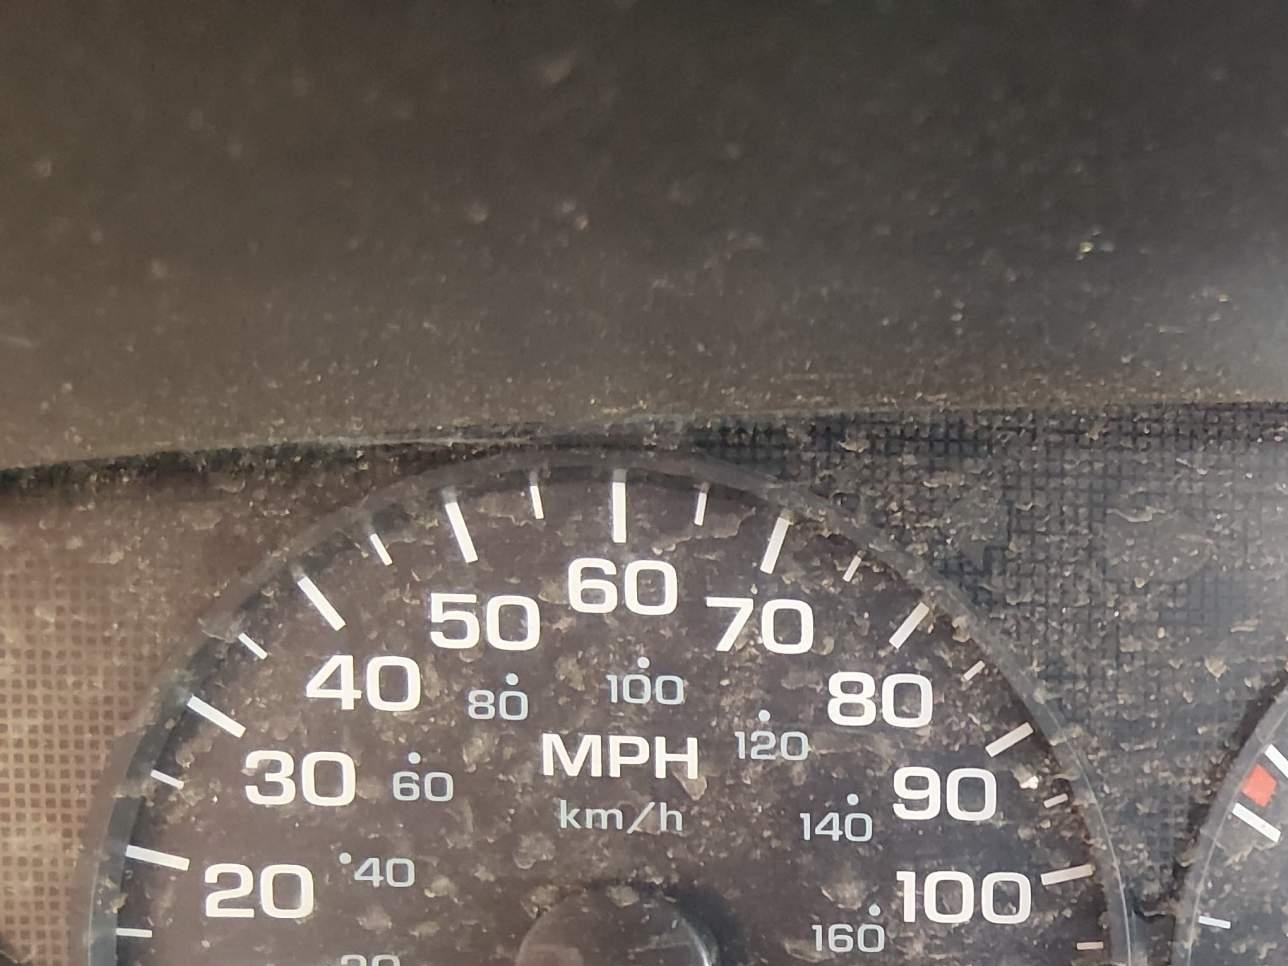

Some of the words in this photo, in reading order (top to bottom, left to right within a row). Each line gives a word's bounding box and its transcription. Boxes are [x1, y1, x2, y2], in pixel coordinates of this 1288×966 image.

[568, 558, 678, 615] 60
[431, 593, 540, 650] 50
[706, 597, 813, 654] 70
[306, 655, 420, 711] 40
[469, 690, 528, 720] 80
[608, 675, 685, 704] 100
[828, 672, 932, 727] 80
[542, 734, 697, 779] MPH
[735, 731, 811, 760] 120
[244, 750, 355, 807] 30
[393, 772, 453, 801] 60
[893, 767, 996, 821] 90
[559, 800, 682, 833] km/h
[800, 813, 872, 841] 140
[205, 864, 313, 918] 20
[354, 858, 415, 887] 40
[897, 871, 1031, 926] 100
[812, 924, 884, 952] 160
